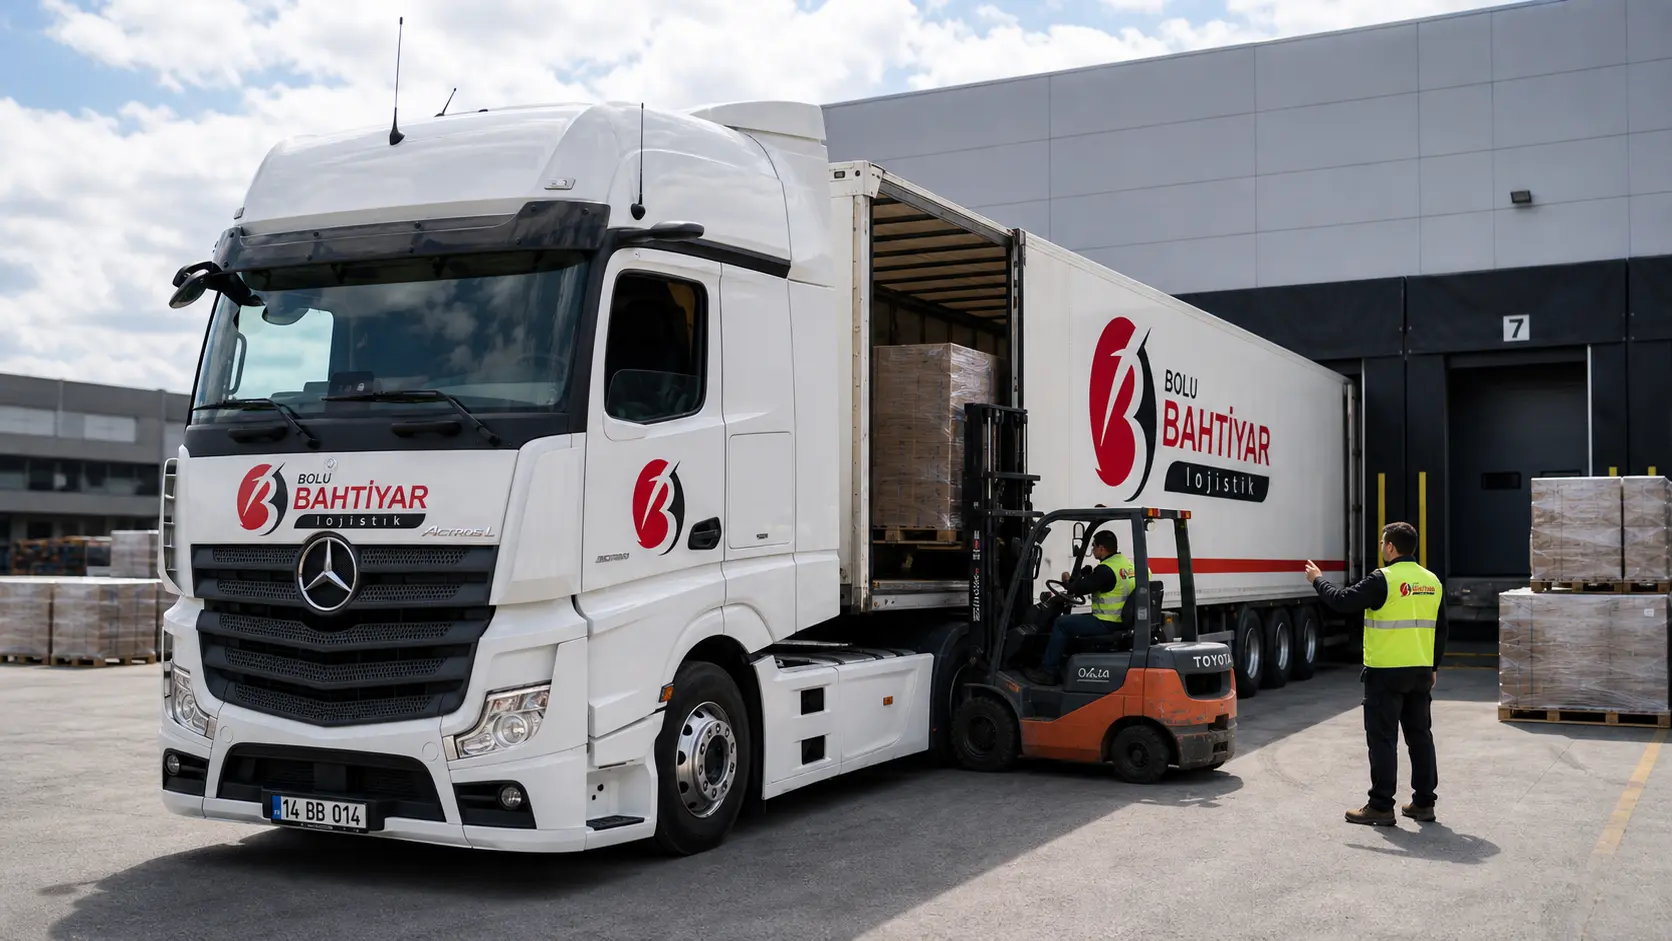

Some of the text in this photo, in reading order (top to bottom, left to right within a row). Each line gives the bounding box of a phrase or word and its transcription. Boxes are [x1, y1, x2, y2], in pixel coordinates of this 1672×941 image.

[1509, 318, 1524, 339] 7
[1164, 369, 1198, 399] BOLU
[1162, 399, 1271, 467] BAHTİYAR
[297, 473, 331, 484] BOLU
[1186, 466, 1254, 496] lojistik
[293, 480, 429, 510] BAHTİYAR
[1193, 653, 1232, 668] TOYOTA
[282, 799, 361, 826] 14 BB 014
